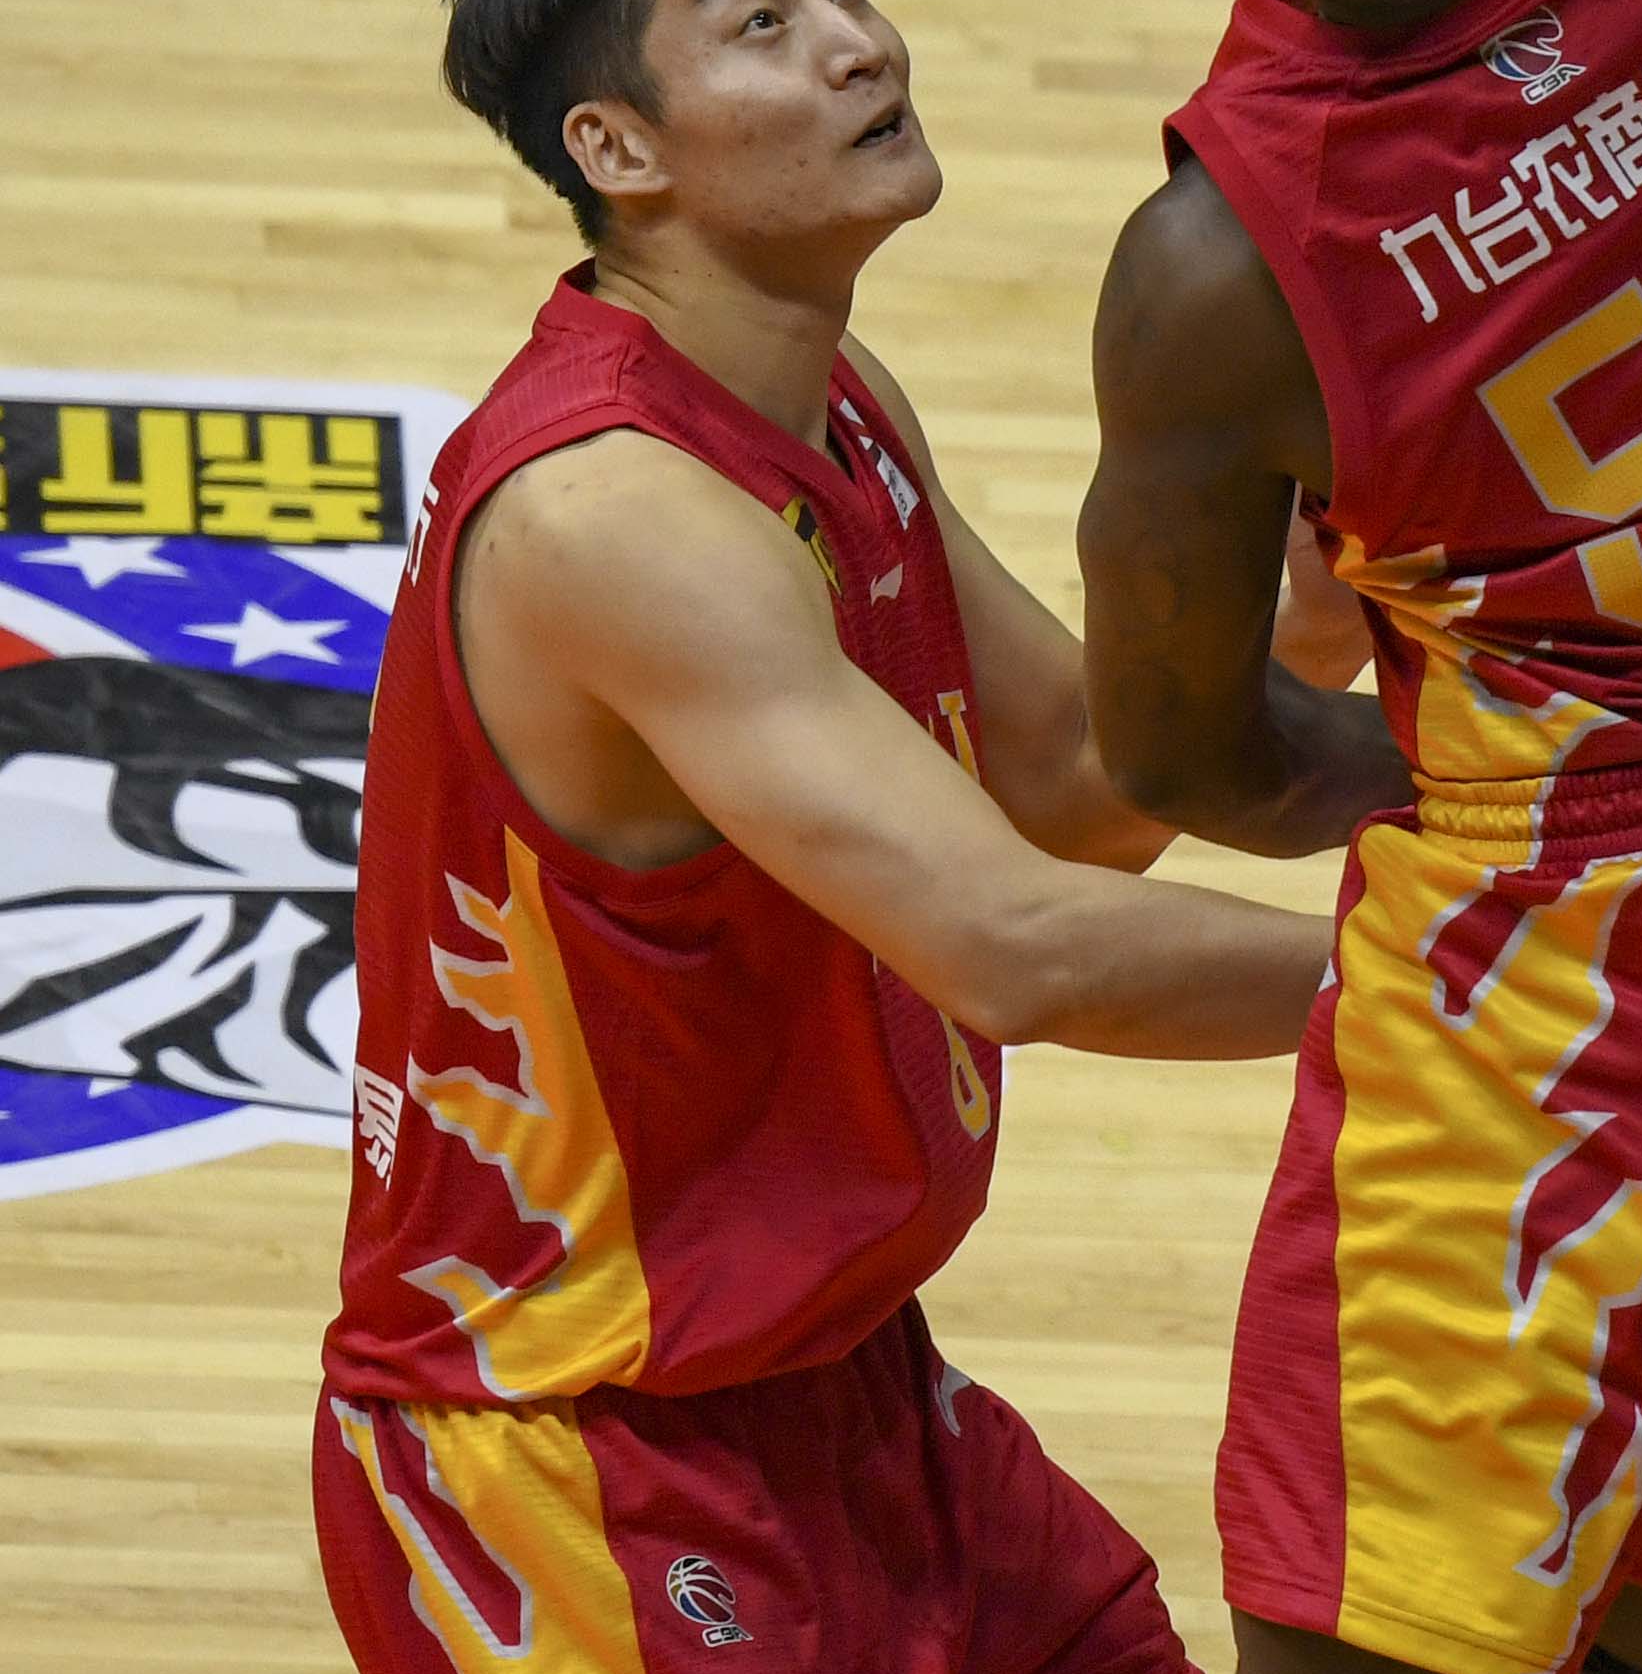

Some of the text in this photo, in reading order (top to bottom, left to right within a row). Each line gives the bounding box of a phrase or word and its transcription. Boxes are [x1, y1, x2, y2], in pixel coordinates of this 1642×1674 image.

[1522, 64, 1586, 104] CBA
[0, 406, 384, 542] 新
[703, 1625, 753, 1647] CBA
